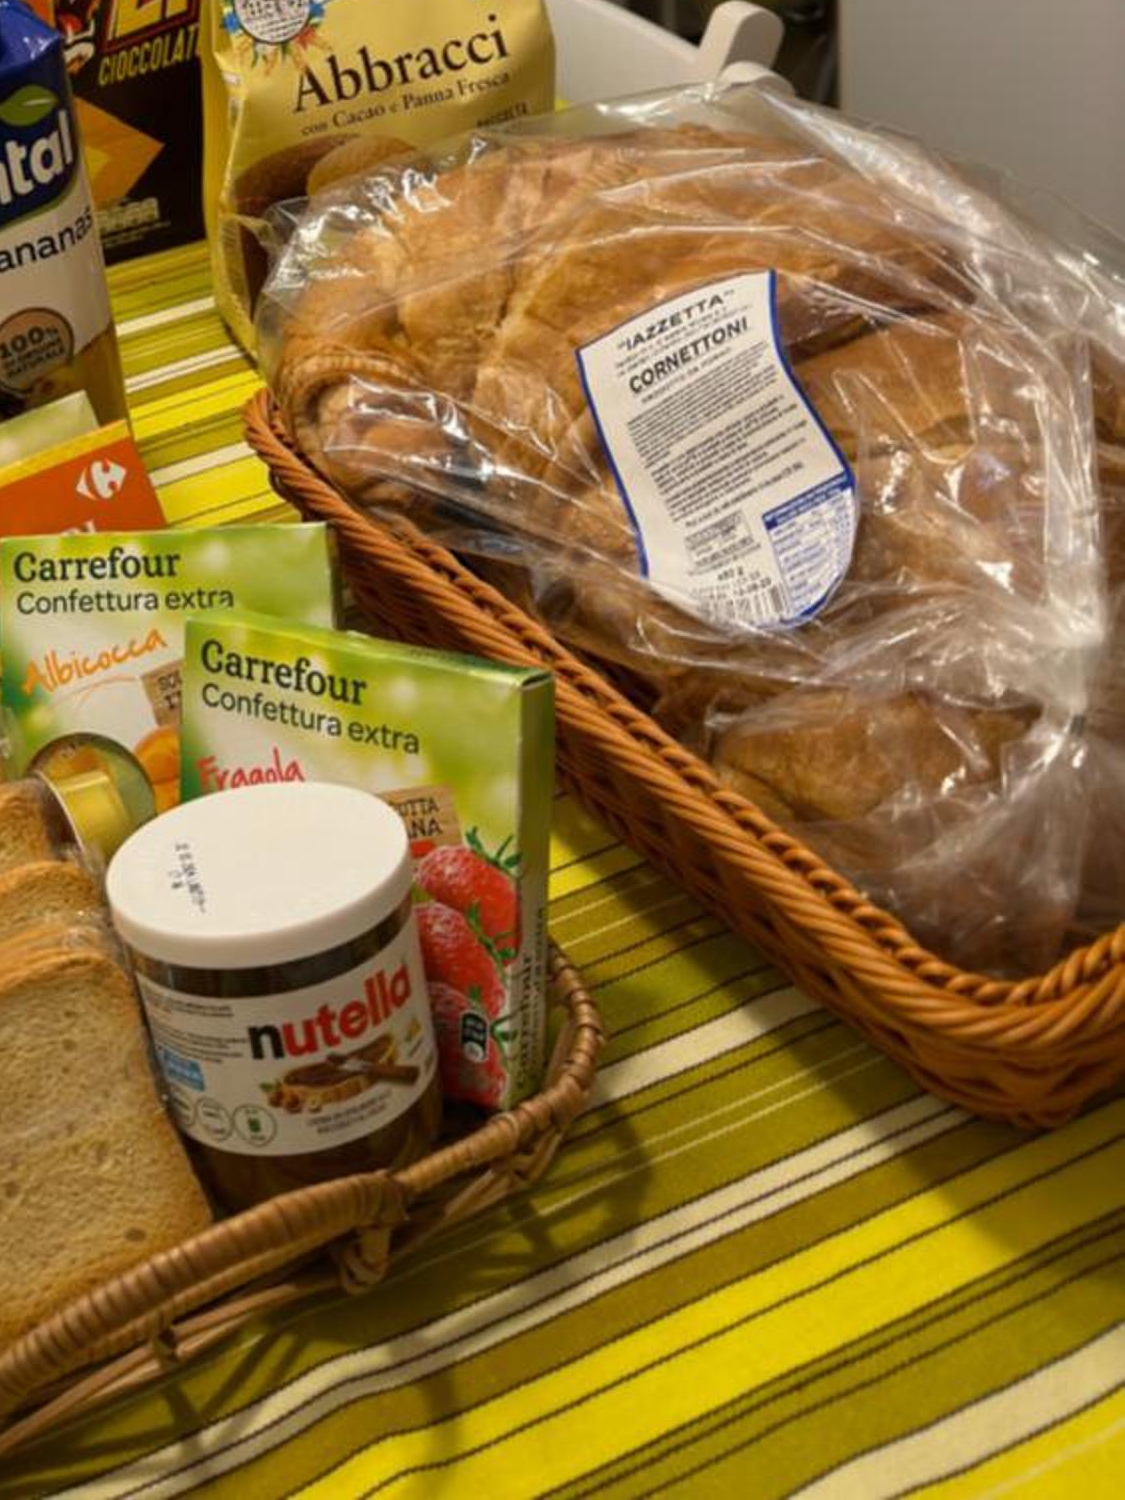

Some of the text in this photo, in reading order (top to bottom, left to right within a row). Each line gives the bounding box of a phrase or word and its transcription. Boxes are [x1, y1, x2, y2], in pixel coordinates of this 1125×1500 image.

[98, 24, 201, 87] CIOCCOLAT
[293, 13, 510, 114] Abbracci
[332, 105, 387, 129] Cacao
[402, 88, 454, 112] Panna
[456, 70, 511, 96] Fresca
[629, 316, 749, 396] CORNETTONI
[13, 546, 181, 583] Carrefour
[17, 587, 235, 615] Confettura extra
[21, 628, 167, 695] Albicocca
[201, 639, 369, 707] Carrefour
[202, 682, 342, 738] Confettura
[347, 720, 420, 755] extra
[246, 964, 413, 1061] nutella
